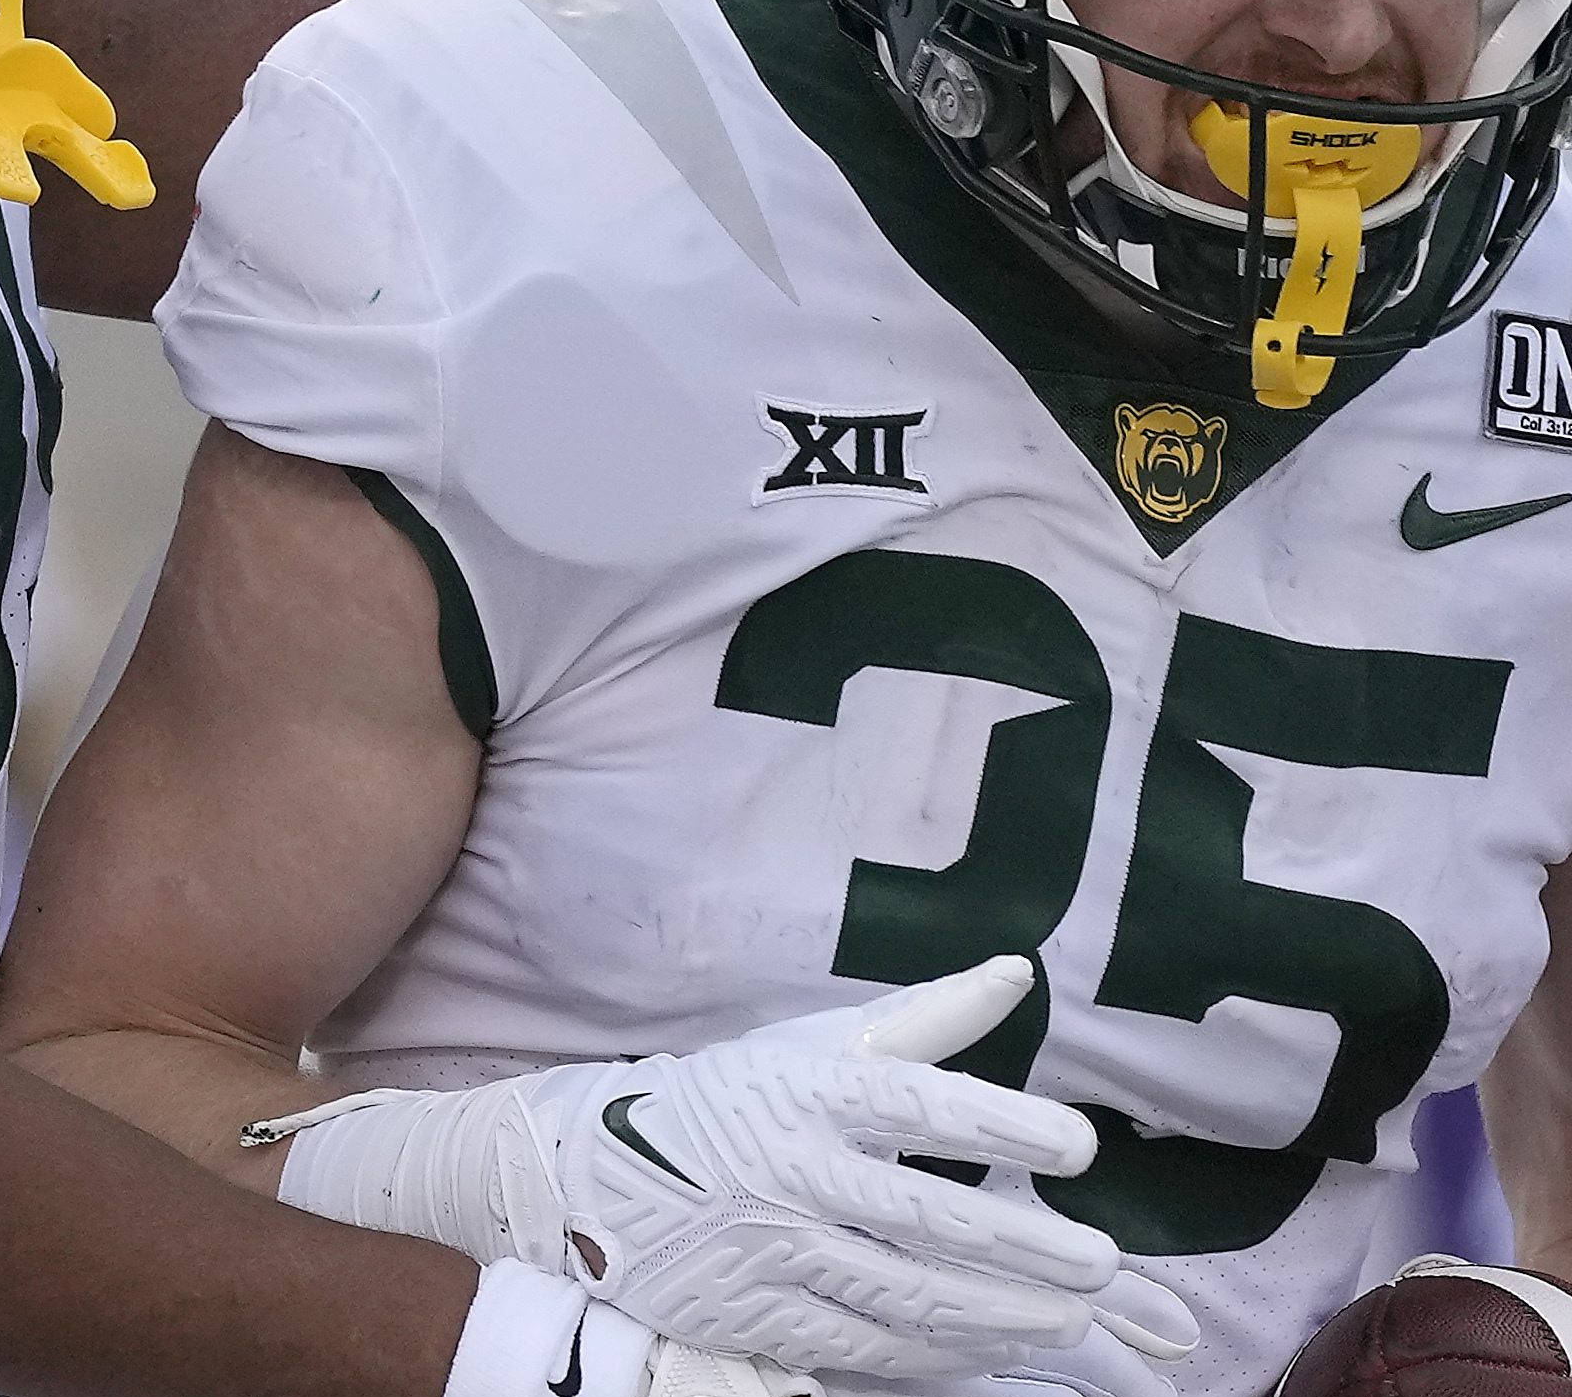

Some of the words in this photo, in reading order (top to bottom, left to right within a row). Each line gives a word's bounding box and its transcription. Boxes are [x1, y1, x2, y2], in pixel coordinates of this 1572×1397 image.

[1289, 130, 1379, 149] SHOCK
[763, 402, 930, 495] XII
[1520, 415, 1542, 432] Col
[714, 548, 1516, 1258] 35
